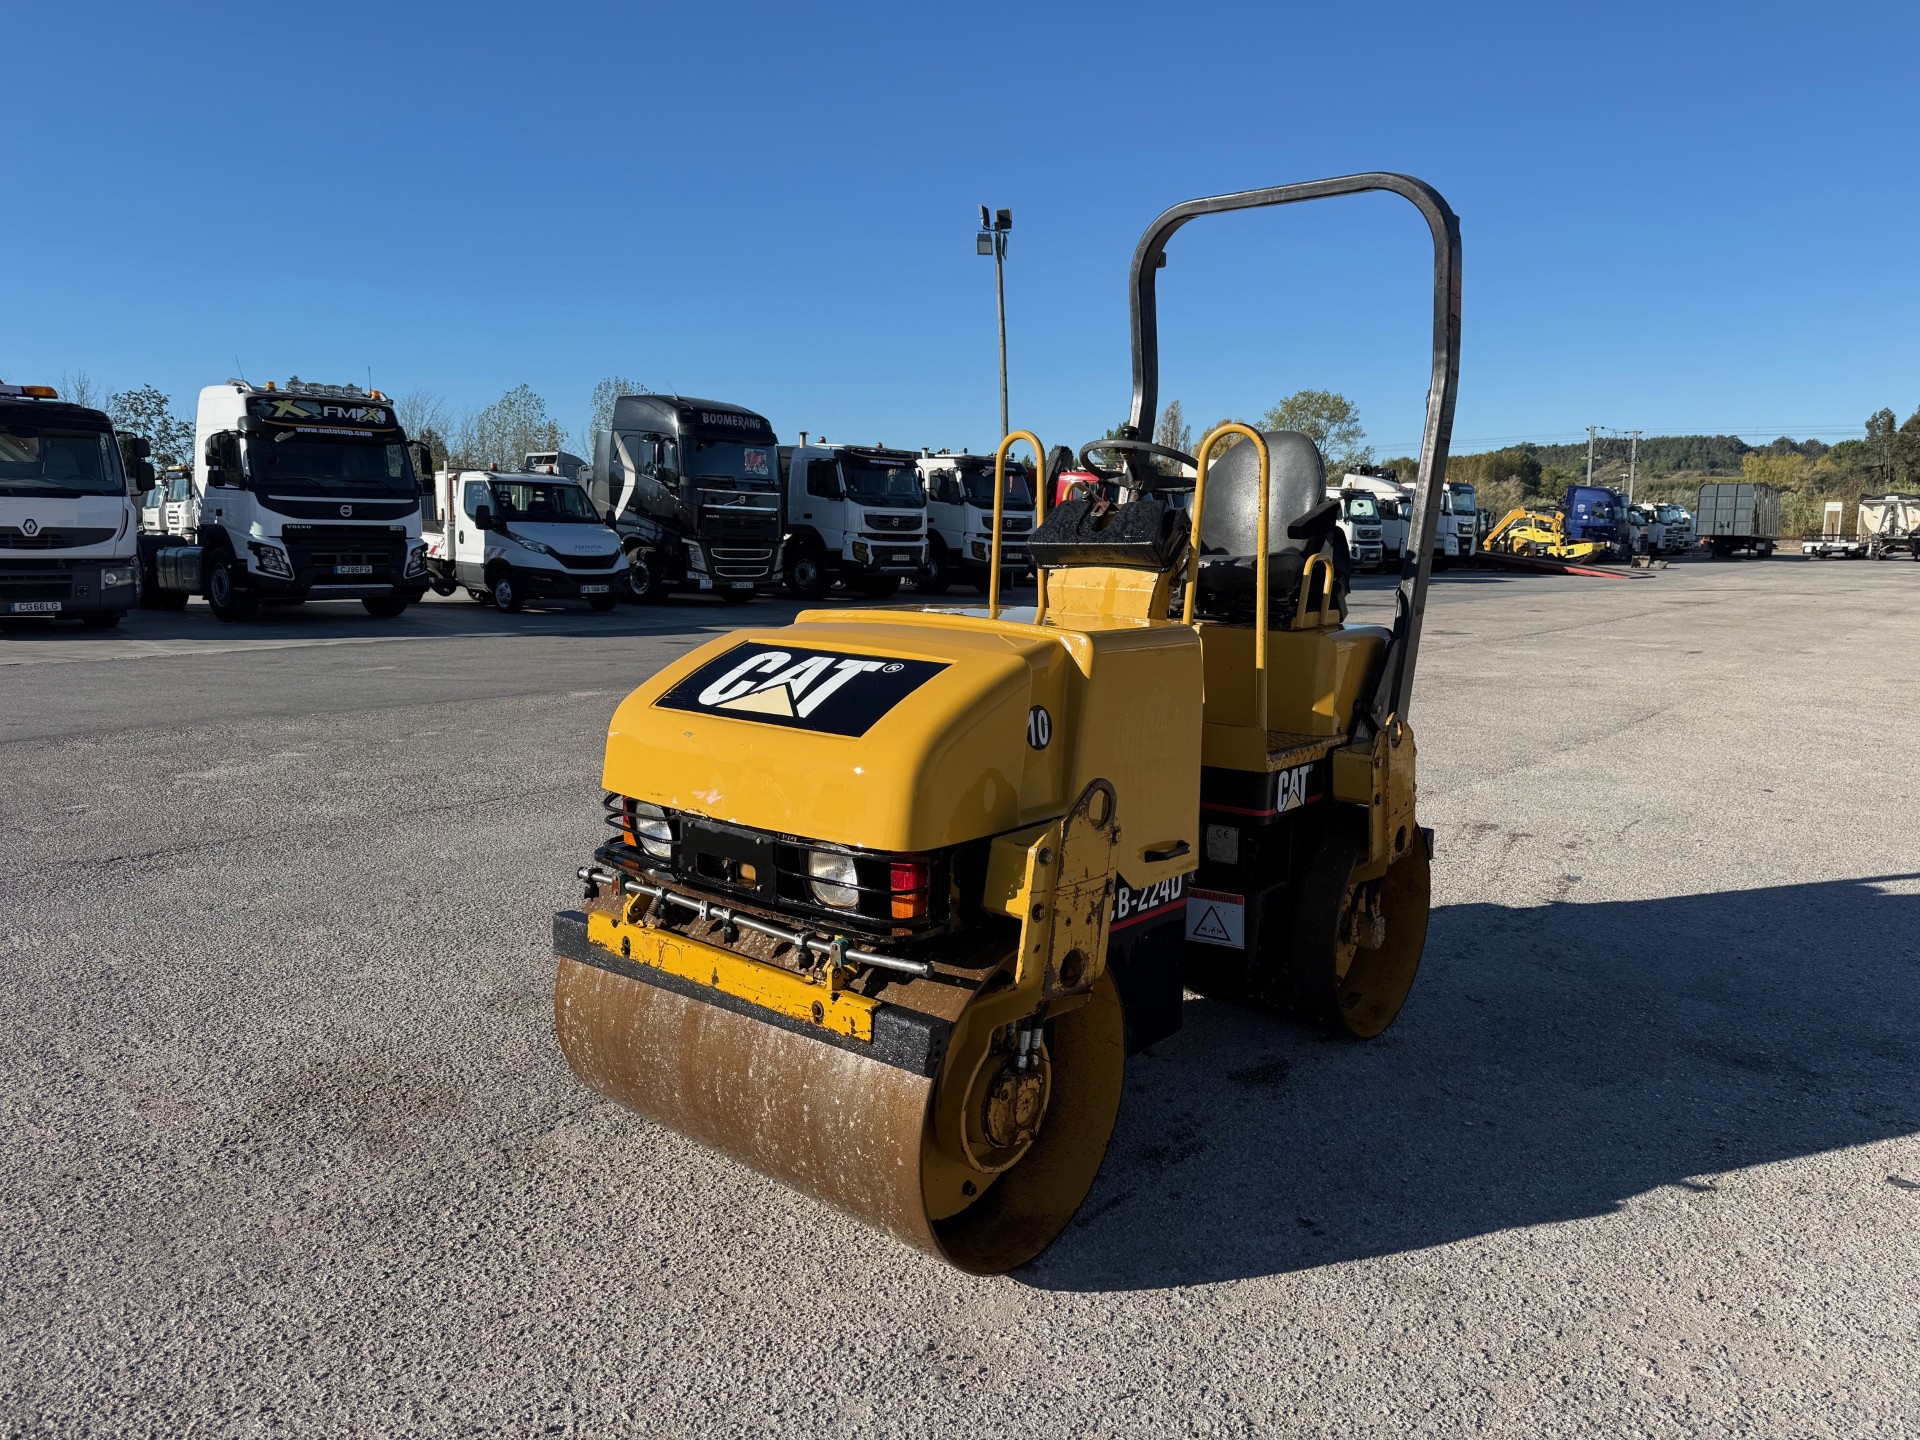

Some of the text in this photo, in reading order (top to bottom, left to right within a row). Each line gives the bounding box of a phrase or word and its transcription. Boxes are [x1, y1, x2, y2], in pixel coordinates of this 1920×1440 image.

[702, 412, 760, 430] BOOMERANG
[698, 651, 888, 718] CAT
[1277, 764, 1310, 813] CAT
[1200, 891, 1239, 904] WARNING
